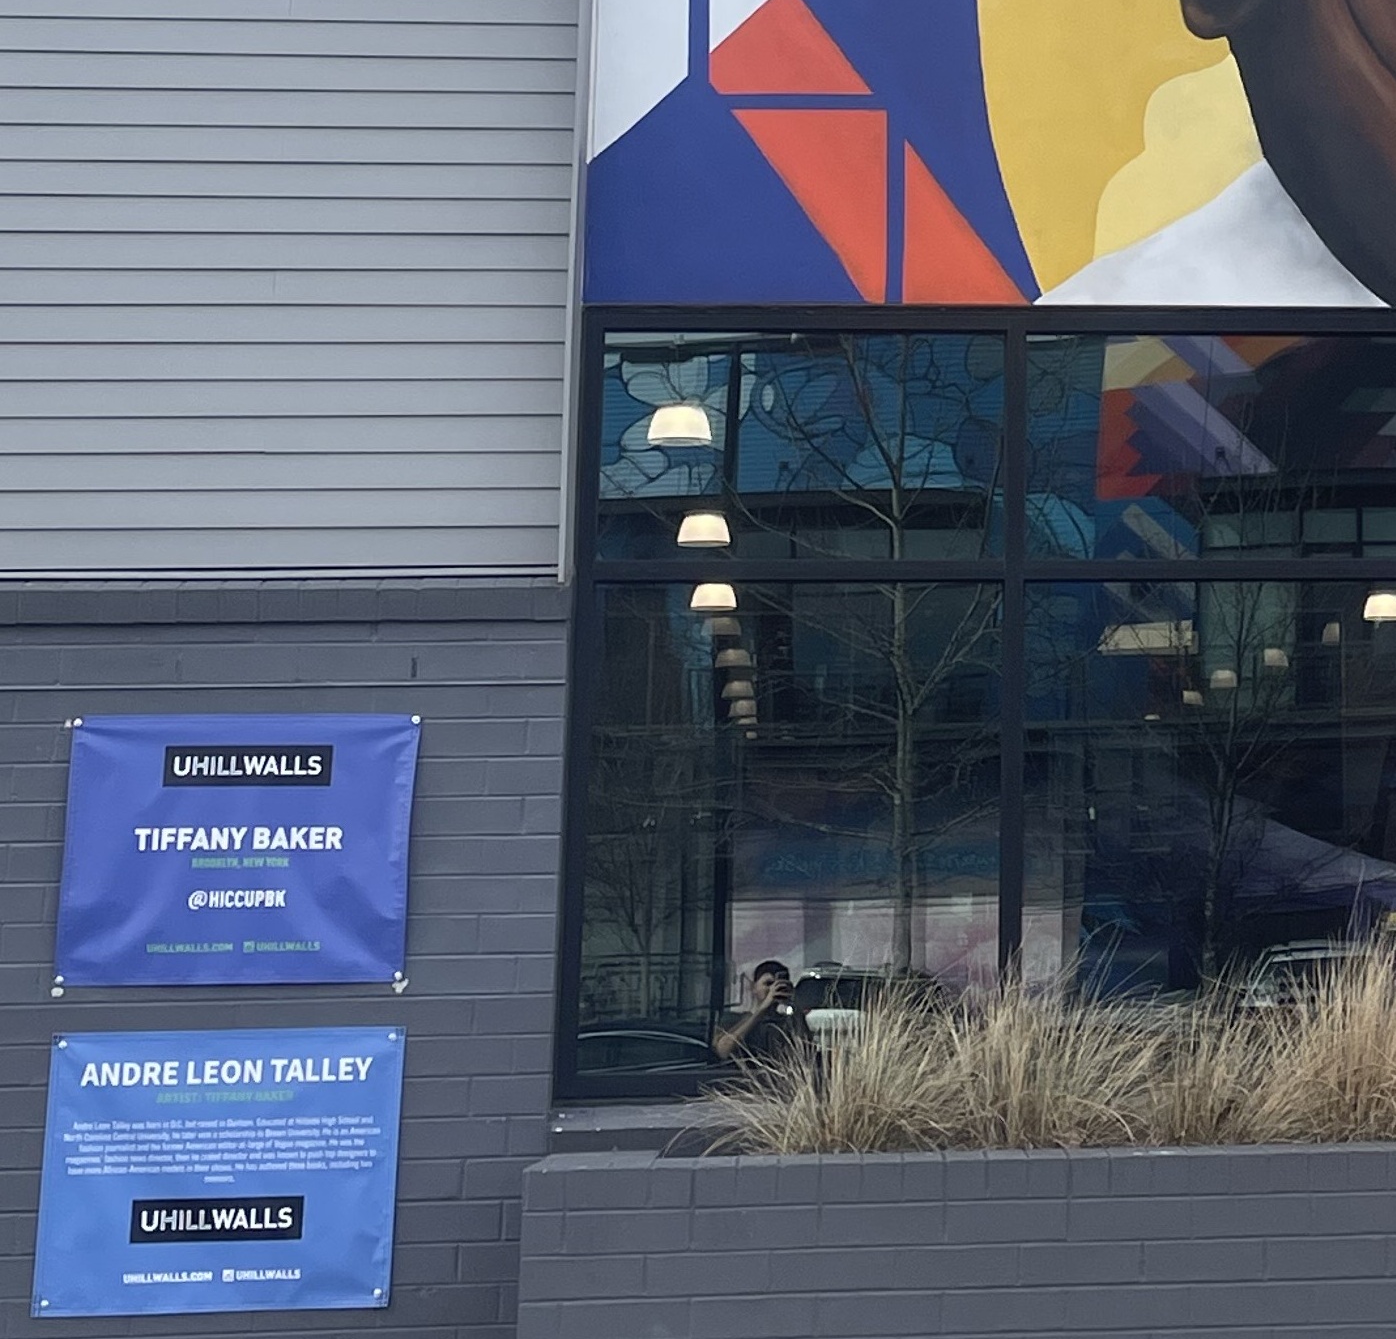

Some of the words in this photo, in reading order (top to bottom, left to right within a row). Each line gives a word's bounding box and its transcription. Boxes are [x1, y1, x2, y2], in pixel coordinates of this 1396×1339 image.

[172, 755, 322, 777] UHILLWALLS
[134, 826, 247, 851] TIFFANY
[252, 826, 343, 850] BAKER
[188, 889, 286, 909] @HICCUPBK
[80, 1061, 179, 1087] ANDRE
[186, 1060, 263, 1085] LEON
[270, 1056, 374, 1082] TALLEY
[140, 1207, 293, 1232] UHILLWALLS
